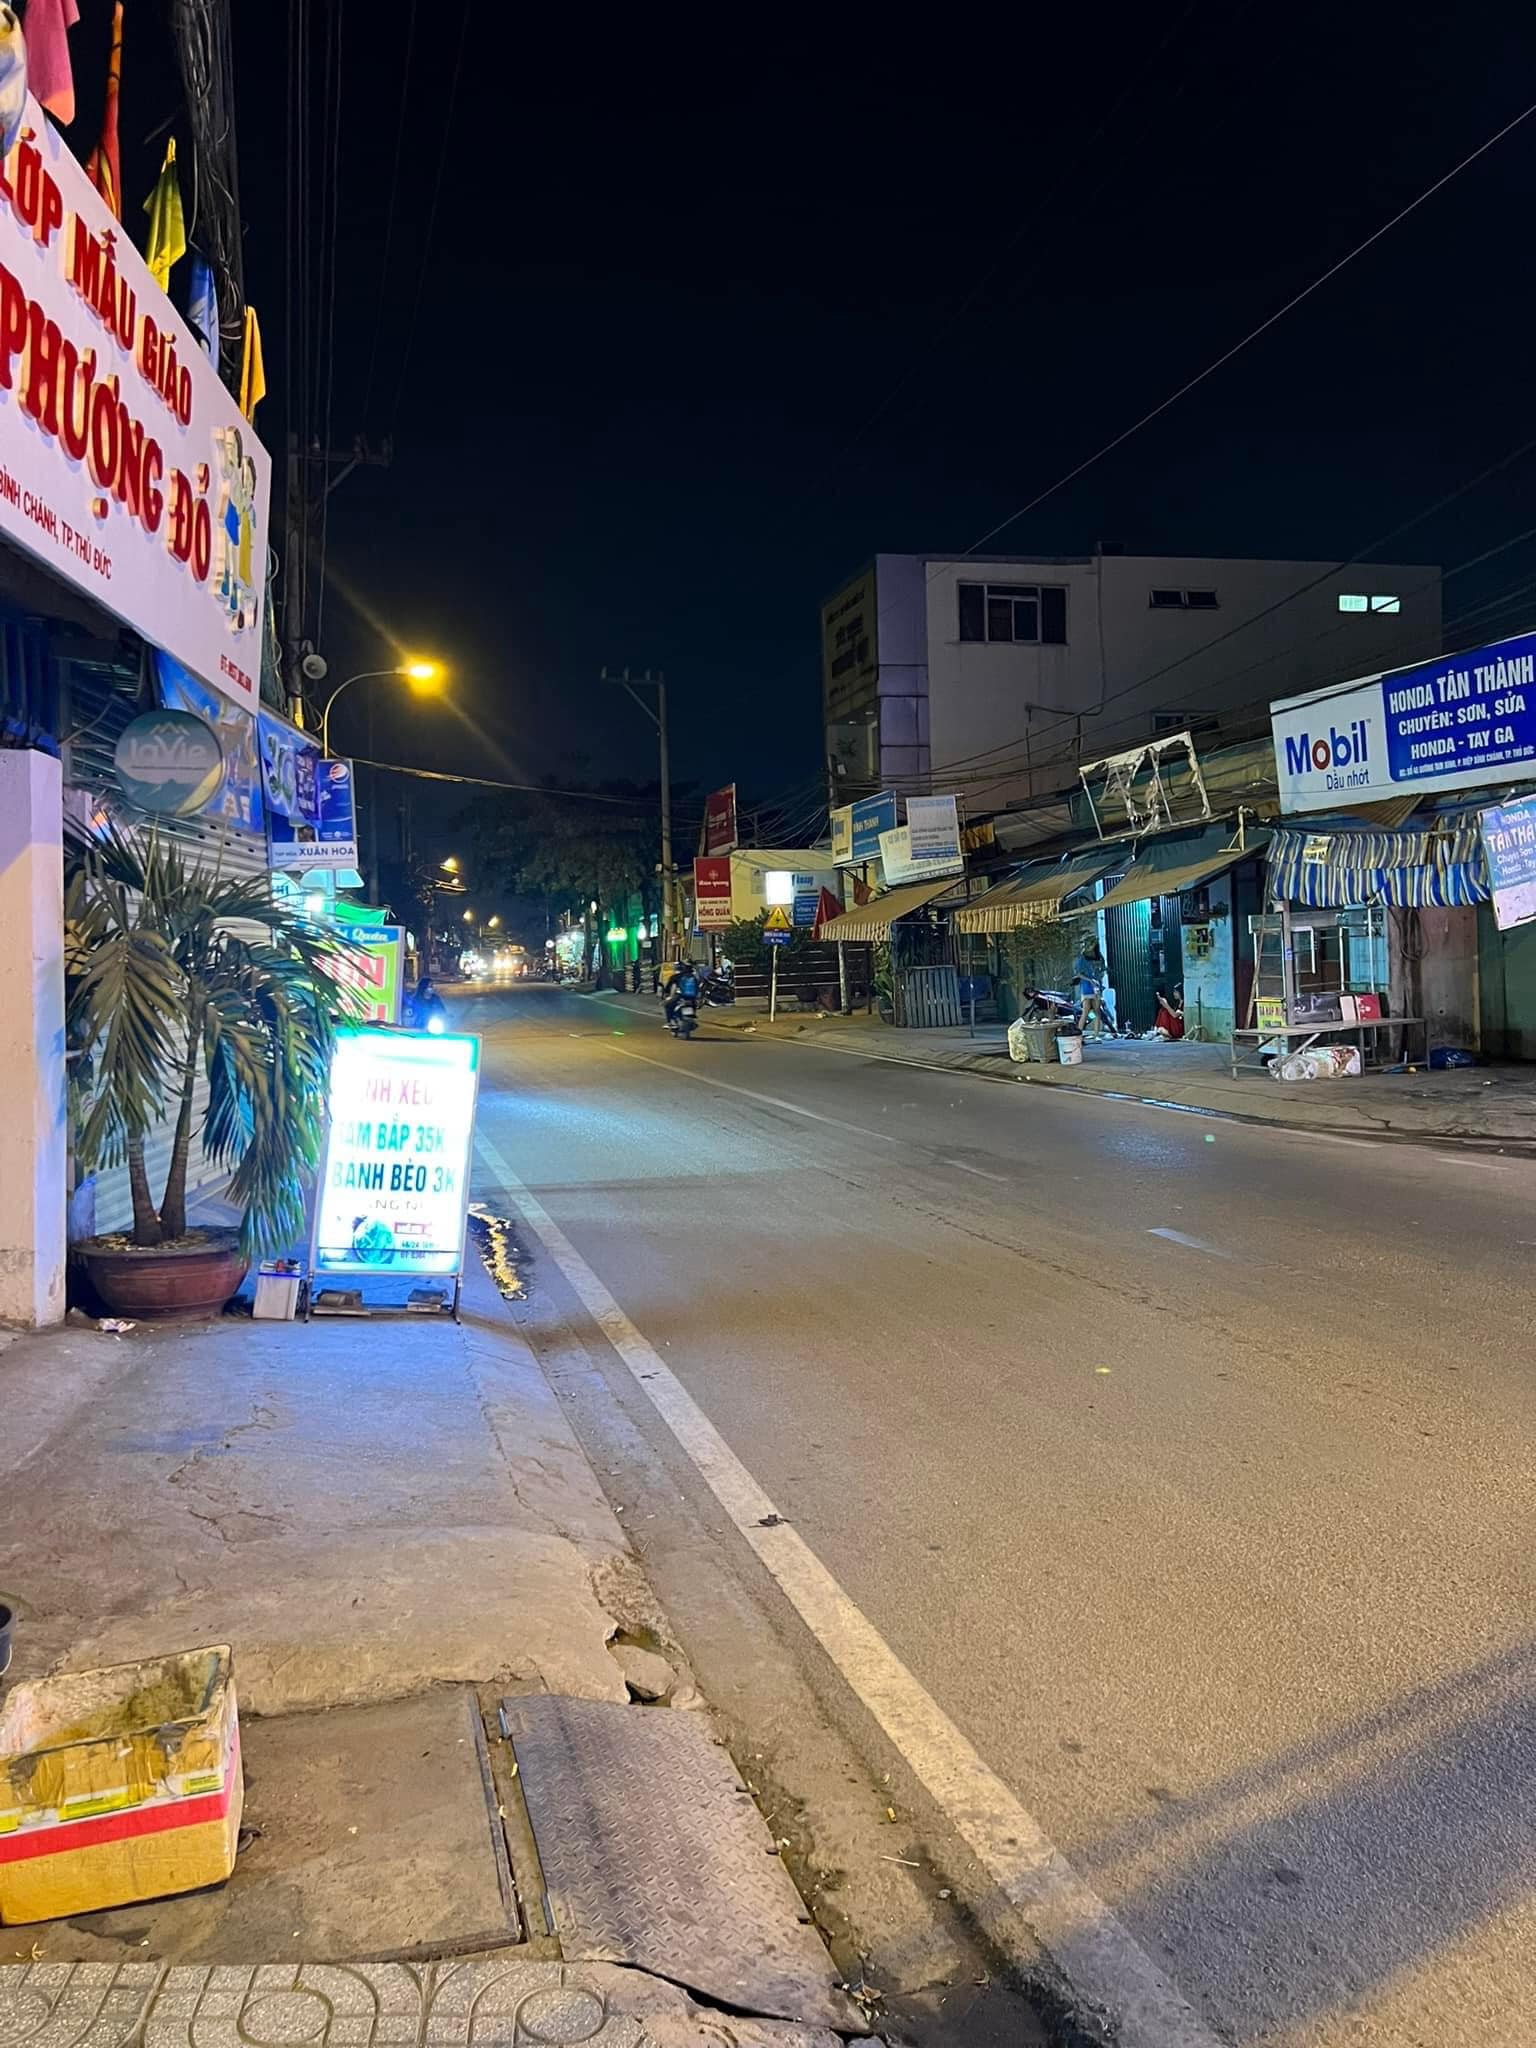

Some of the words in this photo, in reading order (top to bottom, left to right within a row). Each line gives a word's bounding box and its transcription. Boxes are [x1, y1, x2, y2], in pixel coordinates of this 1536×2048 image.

[137, 314, 192, 426] GIÁO
[168, 462, 211, 582] ĐỎ
[1389, 684, 1435, 714] HONDA
[1437, 669, 1471, 702] TÂN
[1474, 655, 1534, 694] THÀNH
[1398, 710, 1454, 736] CHUYÊN:
[1457, 703, 1491, 724] SƠN,
[1494, 691, 1526, 716] SỬA
[1285, 719, 1368, 776] Mobil
[1410, 737, 1456, 760] HONDA
[1467, 730, 1490, 749] TAY
[1494, 726, 1515, 744] GA
[299, 846, 329, 857] XUÂN
